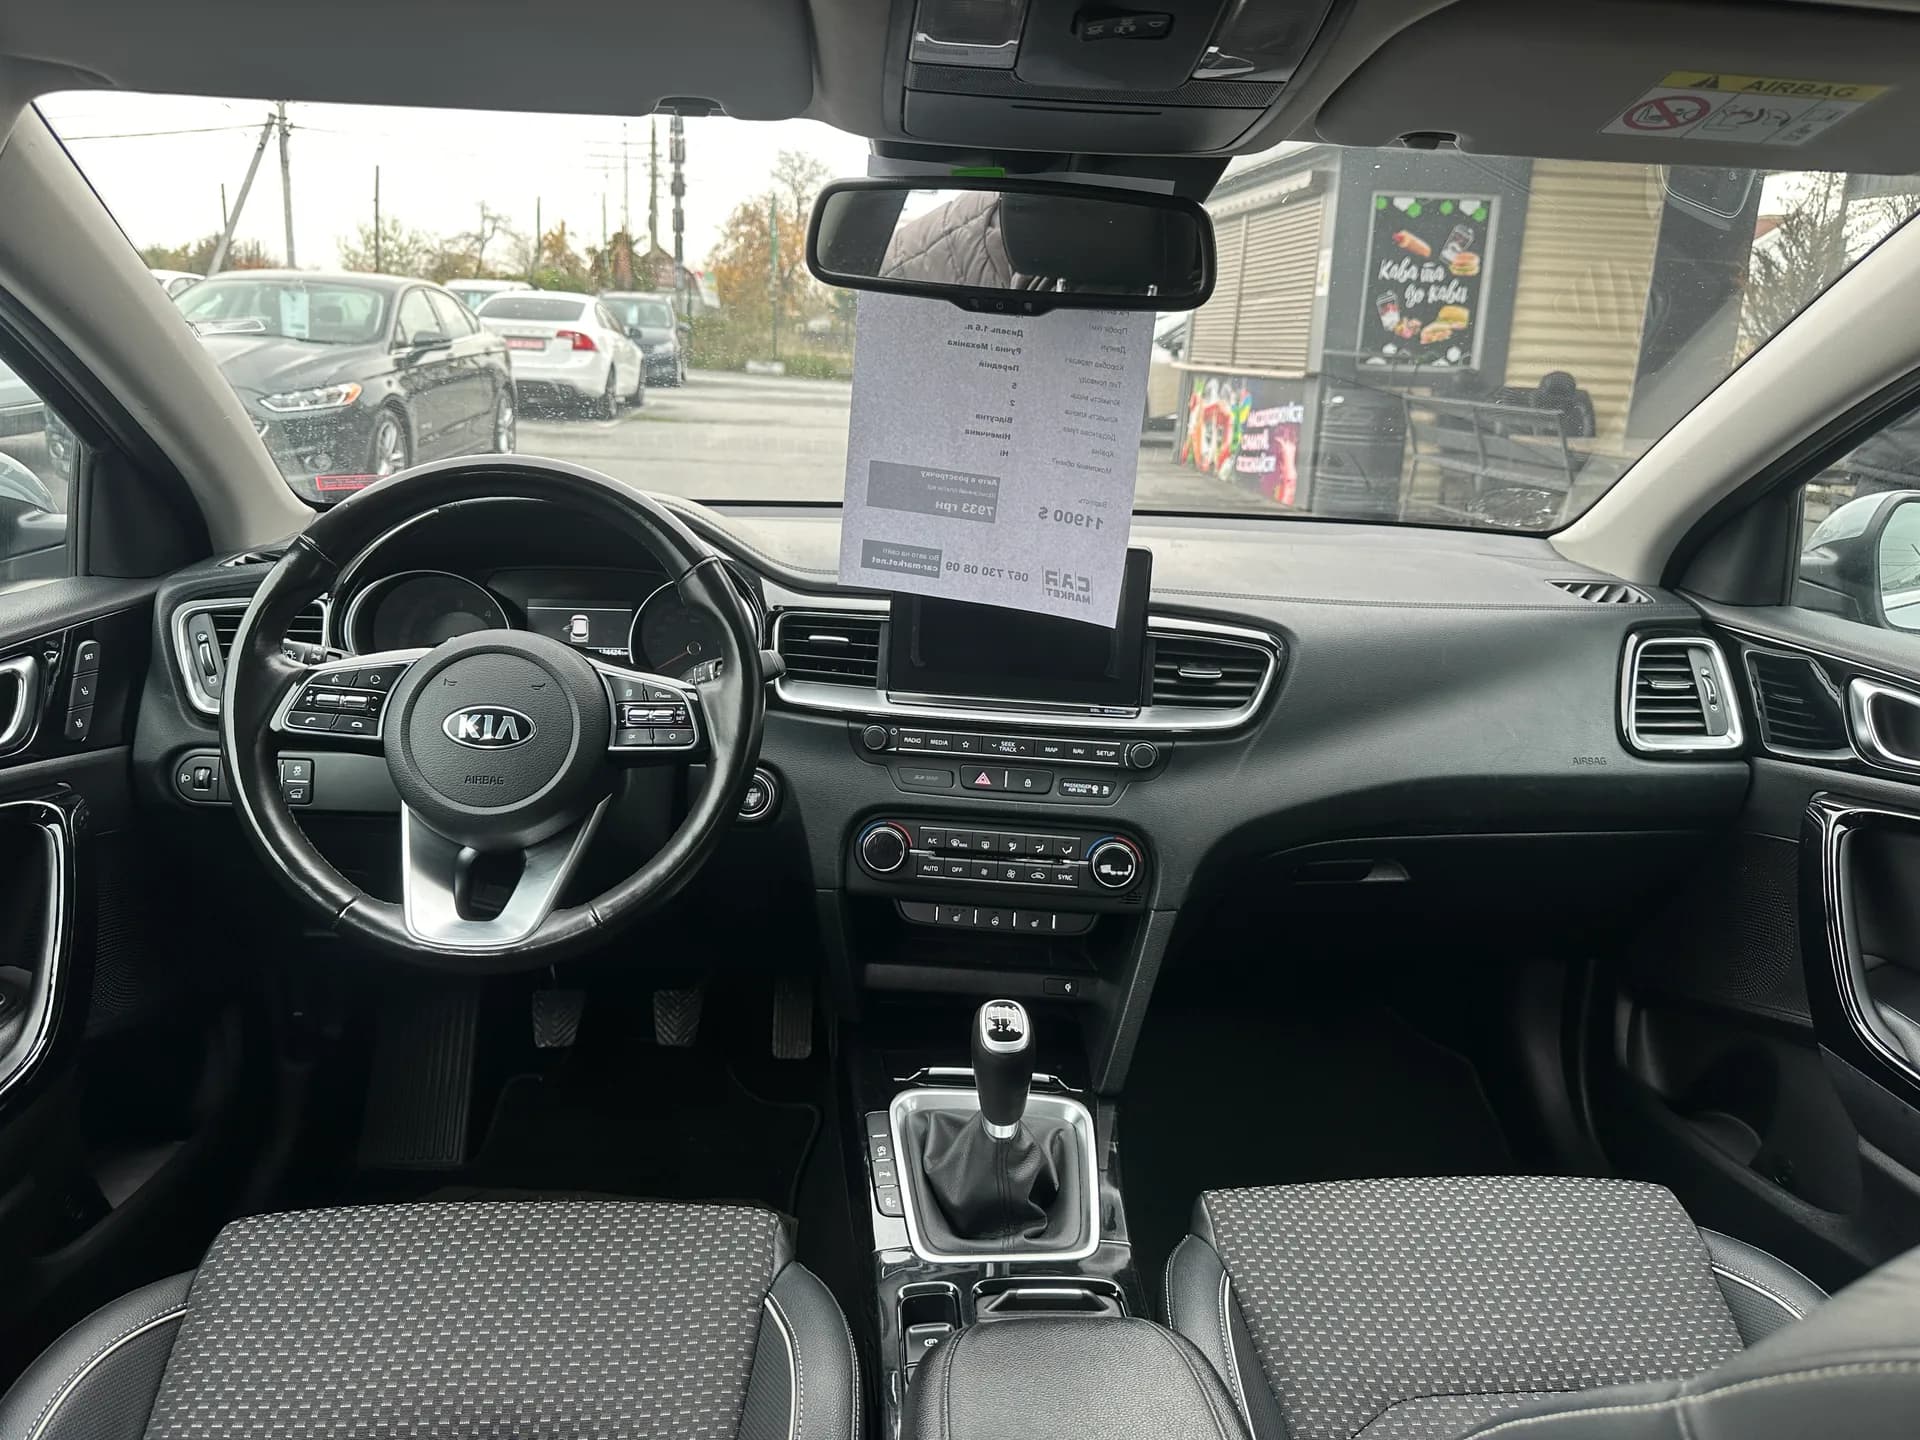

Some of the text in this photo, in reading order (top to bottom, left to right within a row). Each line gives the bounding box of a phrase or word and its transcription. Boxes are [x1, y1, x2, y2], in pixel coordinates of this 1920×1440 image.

[1747, 80, 1859, 98] AIRBAG
[1378, 256, 1418, 283] Кава
[1428, 278, 1468, 304] кави
[458, 714, 520, 740] KIA
[903, 736, 922, 744] RADIO
[999, 745, 1017, 753] TRACK
[1572, 756, 1607, 766] AIRBAG
[464, 775, 504, 785] AIRBAG
[927, 837, 938, 845] A/C
